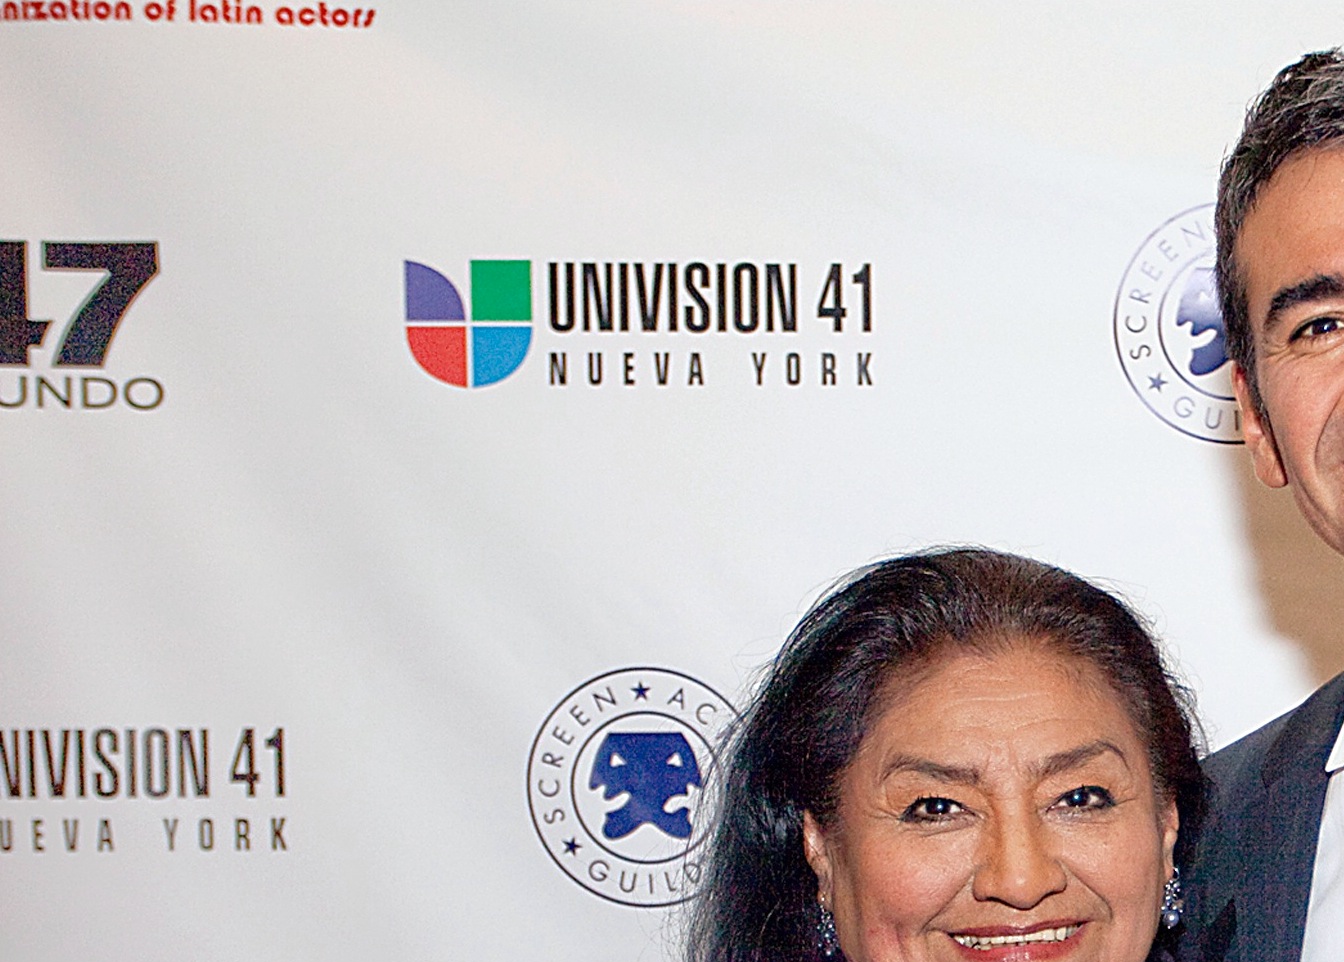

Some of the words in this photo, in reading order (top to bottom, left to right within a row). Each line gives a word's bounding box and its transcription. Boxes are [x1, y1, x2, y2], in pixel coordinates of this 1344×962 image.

[144, 1, 175, 22] of
[189, 0, 263, 24] latin
[275, 3, 376, 27] actors
[548, 262, 798, 333] UNIVISION
[816, 262, 873, 332] 41
[1125, 219, 1208, 360] SCREEN
[548, 352, 706, 386] NUEVA
[752, 352, 875, 386] YORK
[229, 728, 287, 798] 41
[538, 686, 619, 826] SCREEN
[163, 817, 288, 852] YORK
